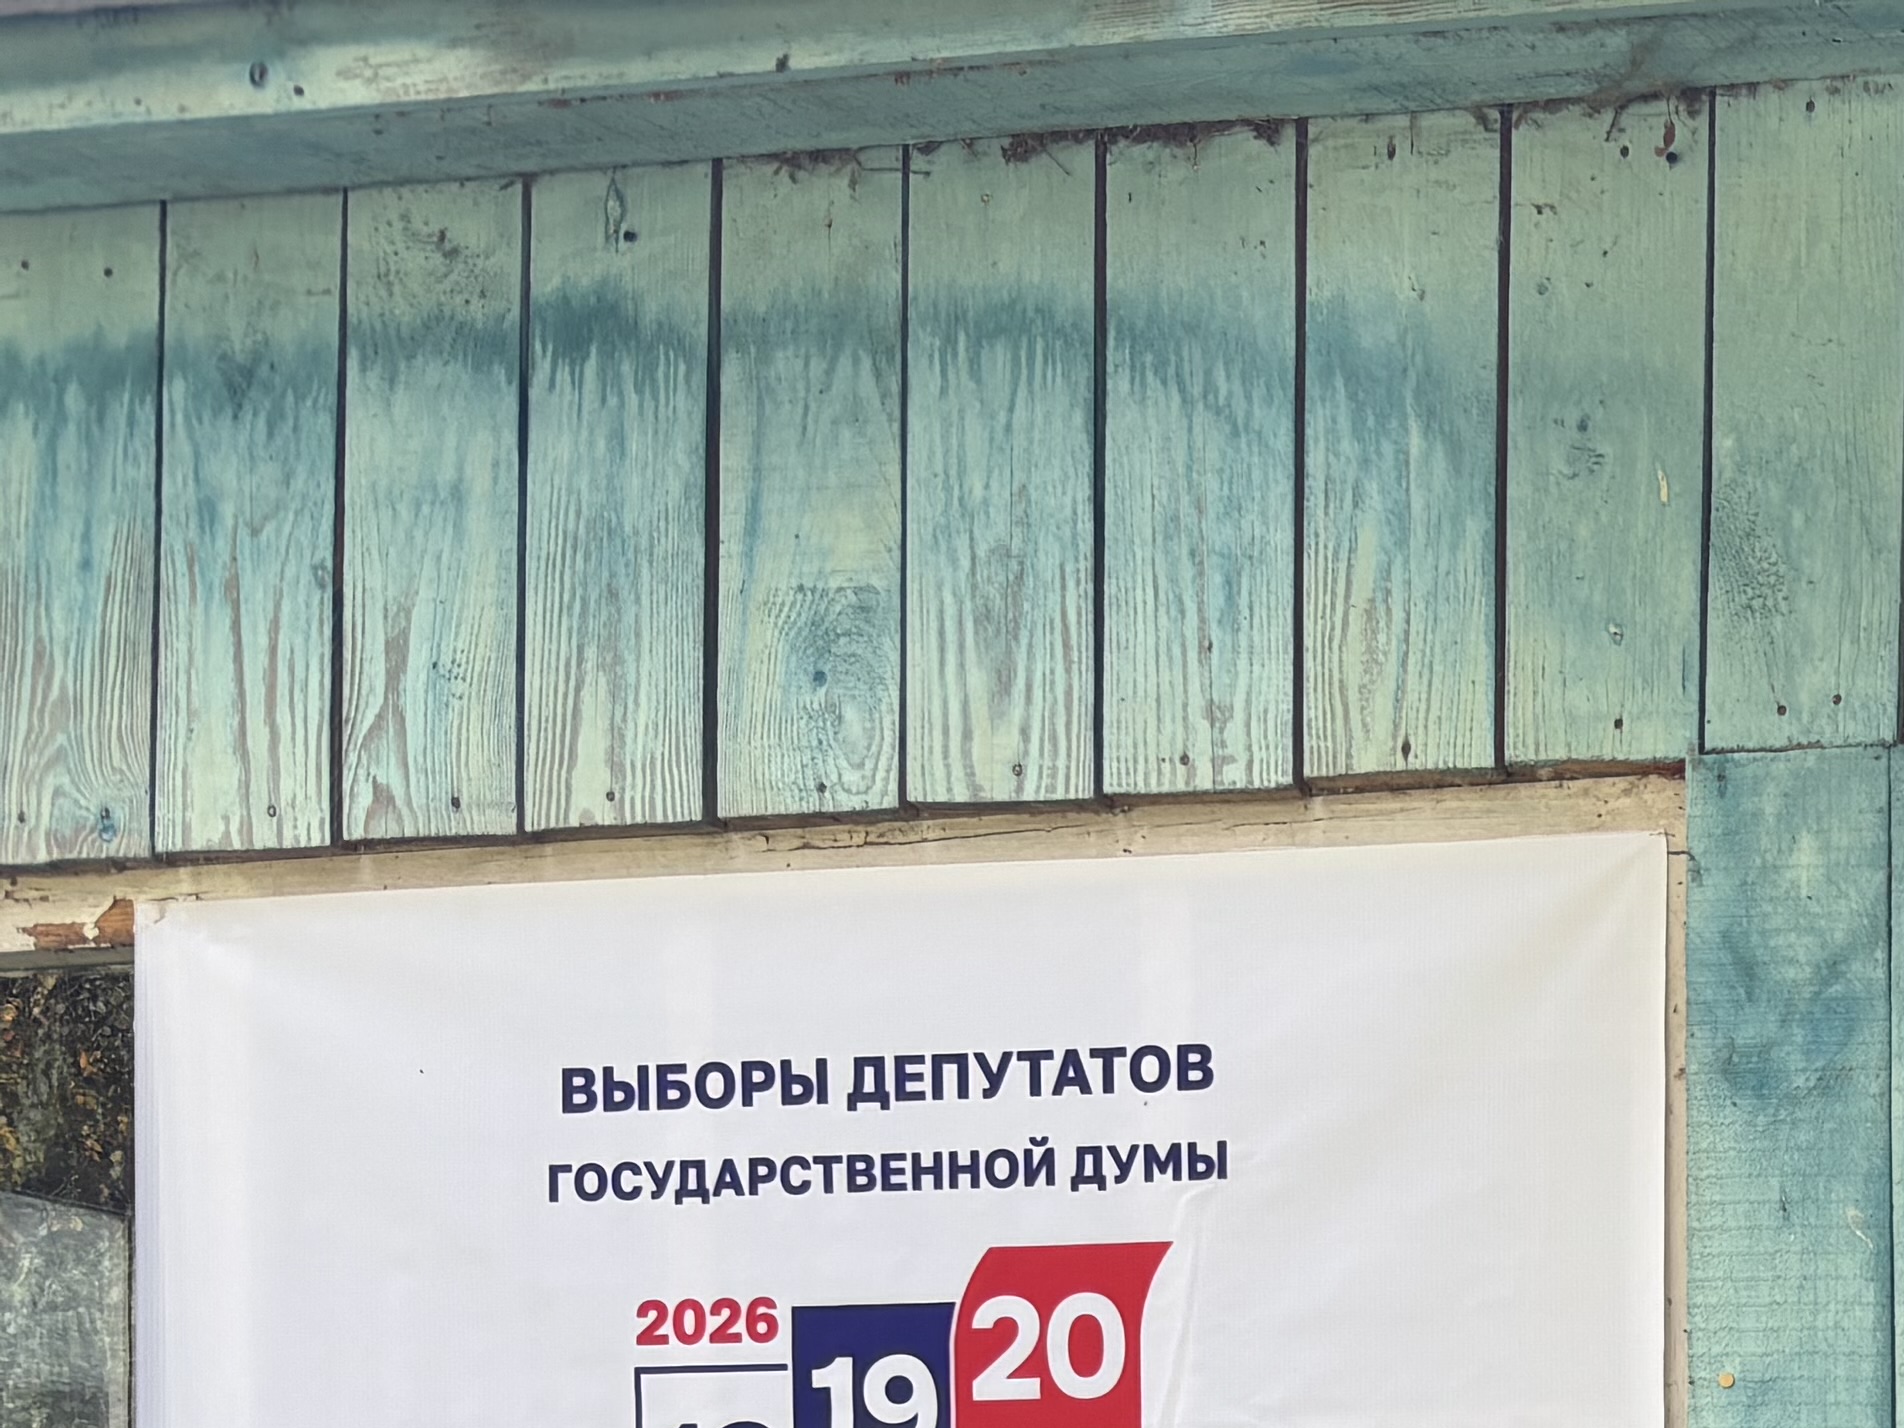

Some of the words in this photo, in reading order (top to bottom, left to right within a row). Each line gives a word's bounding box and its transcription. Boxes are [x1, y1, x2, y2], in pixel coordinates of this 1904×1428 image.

[560, 1058, 829, 1114] ВЫБОРЫ
[846, 1042, 1215, 1114] ДЕПУТАТОВ
[547, 1136, 1057, 1203] ГОСУДАРСТВЕННОЙ
[1070, 1140, 1228, 1193] ДУМЫ
[635, 1297, 778, 1345] 2026
[970, 1291, 1126, 1401] 20
